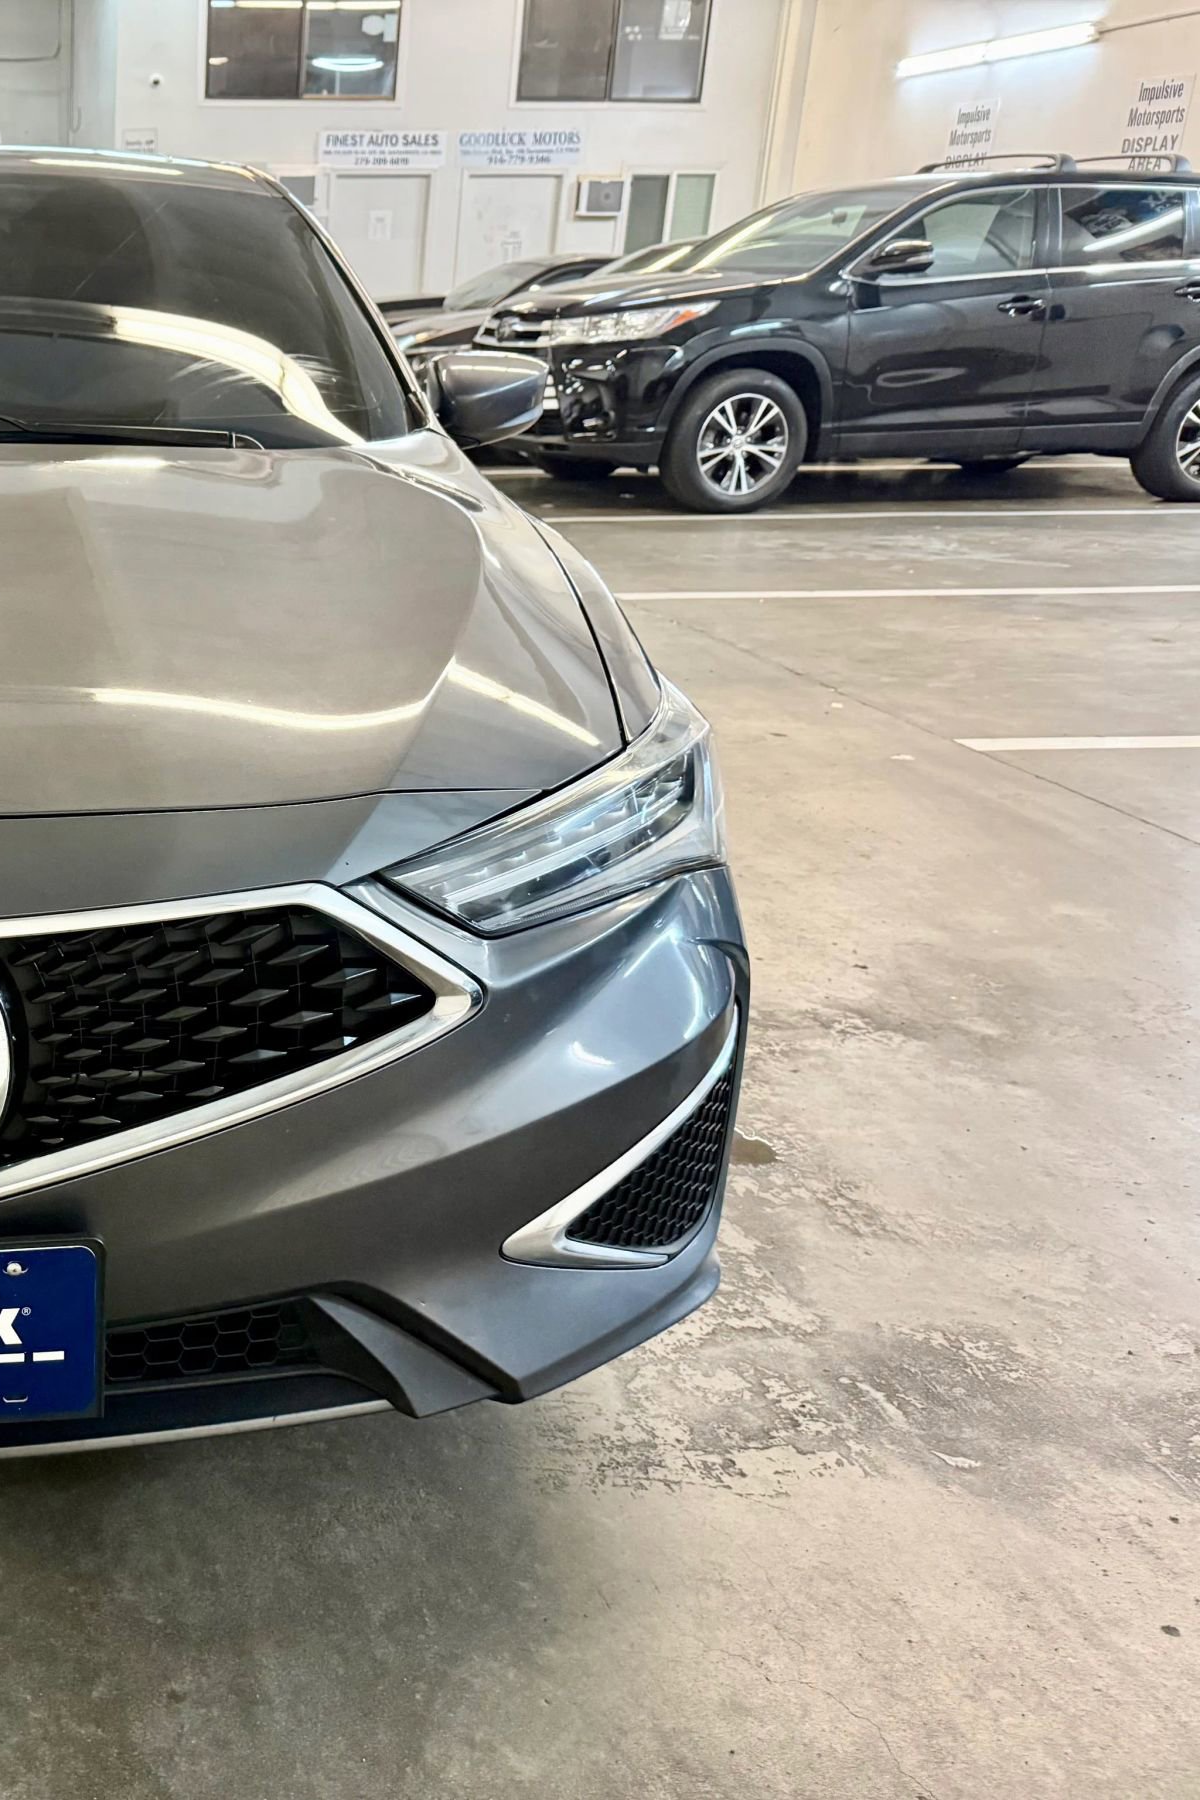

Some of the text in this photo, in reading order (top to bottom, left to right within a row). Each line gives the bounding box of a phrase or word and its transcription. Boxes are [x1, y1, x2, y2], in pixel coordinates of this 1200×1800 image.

[1138, 79, 1184, 106] Impulsive
[956, 104, 991, 128] Impulsive
[1127, 106, 1186, 130] Motorsports
[325, 133, 440, 147] FINEST AUTO SALES
[459, 130, 581, 147] GOODLUCK MOTORS
[948, 128, 992, 148] Motorsports
[1121, 134, 1179, 154] DISPLAY
